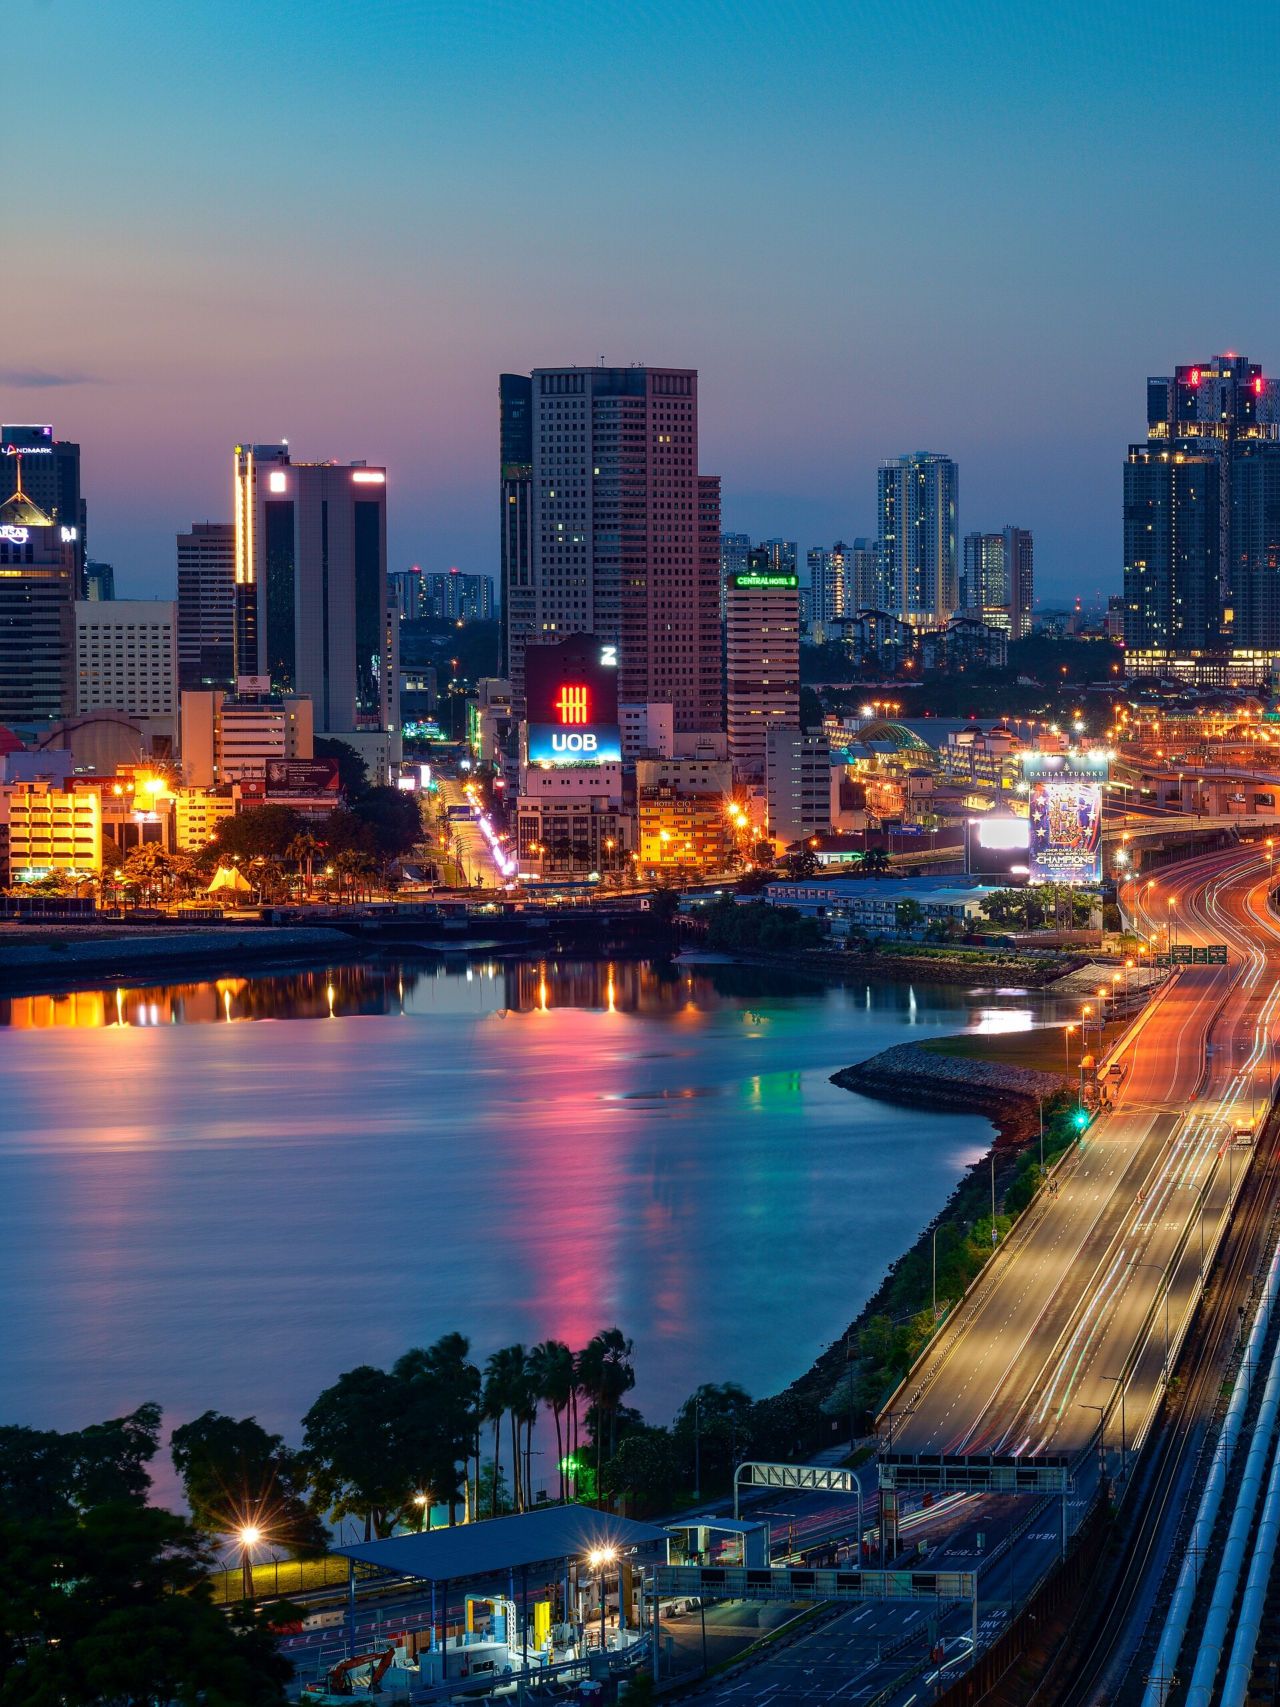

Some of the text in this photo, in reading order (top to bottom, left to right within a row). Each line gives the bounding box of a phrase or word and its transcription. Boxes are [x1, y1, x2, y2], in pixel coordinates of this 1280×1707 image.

[1, 445, 52, 455] LANDMARK
[737, 577, 769, 585] CENTRAL
[552, 734, 597, 751] UOB
[1036, 856, 1095, 864] CHAMPIONS
